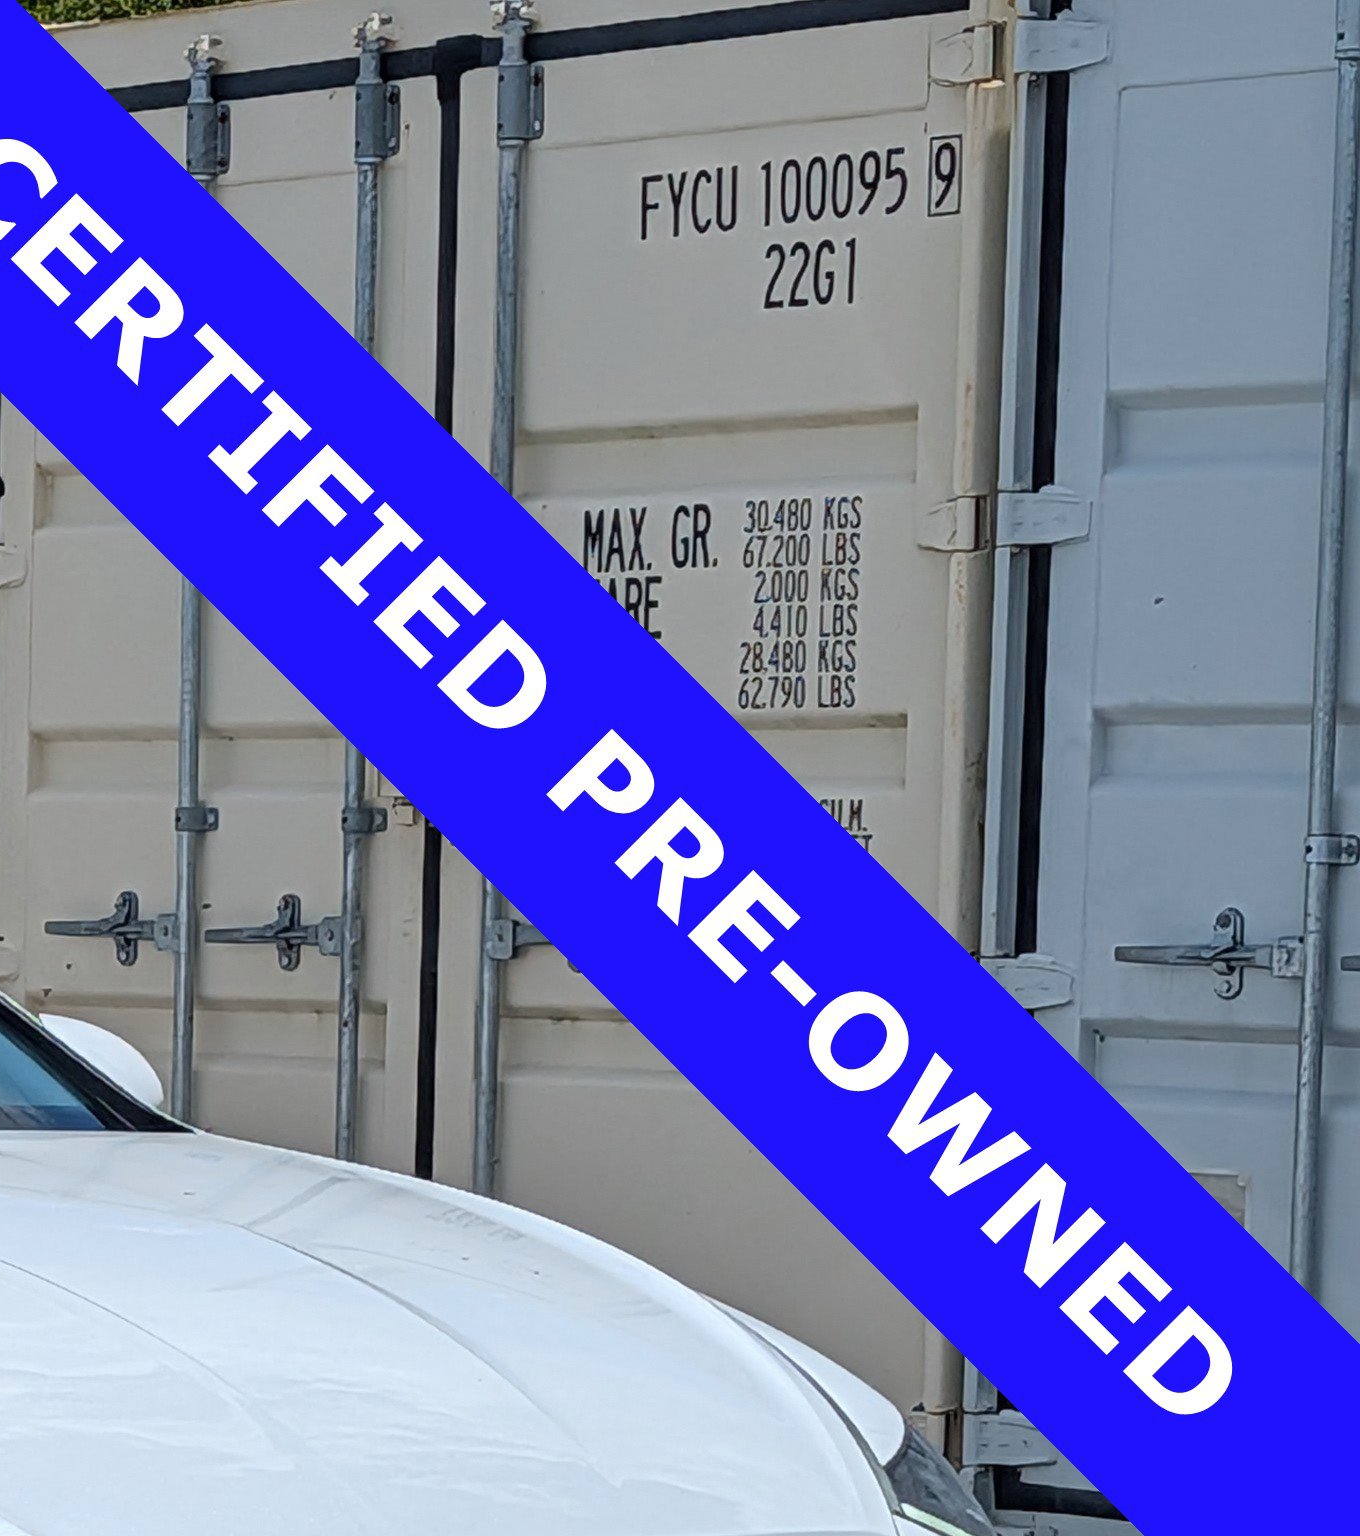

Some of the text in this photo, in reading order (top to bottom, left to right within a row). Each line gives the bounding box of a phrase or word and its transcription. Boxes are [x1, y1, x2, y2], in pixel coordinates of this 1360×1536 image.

[641, 142, 956, 240] FYCU 100095 9
[764, 237, 856, 309] 22G1
[583, 506, 652, 573] MAX.
[671, 503, 718, 569] GR.
[823, 496, 863, 531] KGS
[743, 532, 861, 568] 67.200 LBS
[820, 567, 860, 601] KGS
[819, 604, 858, 637] LBS
[817, 640, 857, 673] KGS
[817, 675, 856, 708] LBS
